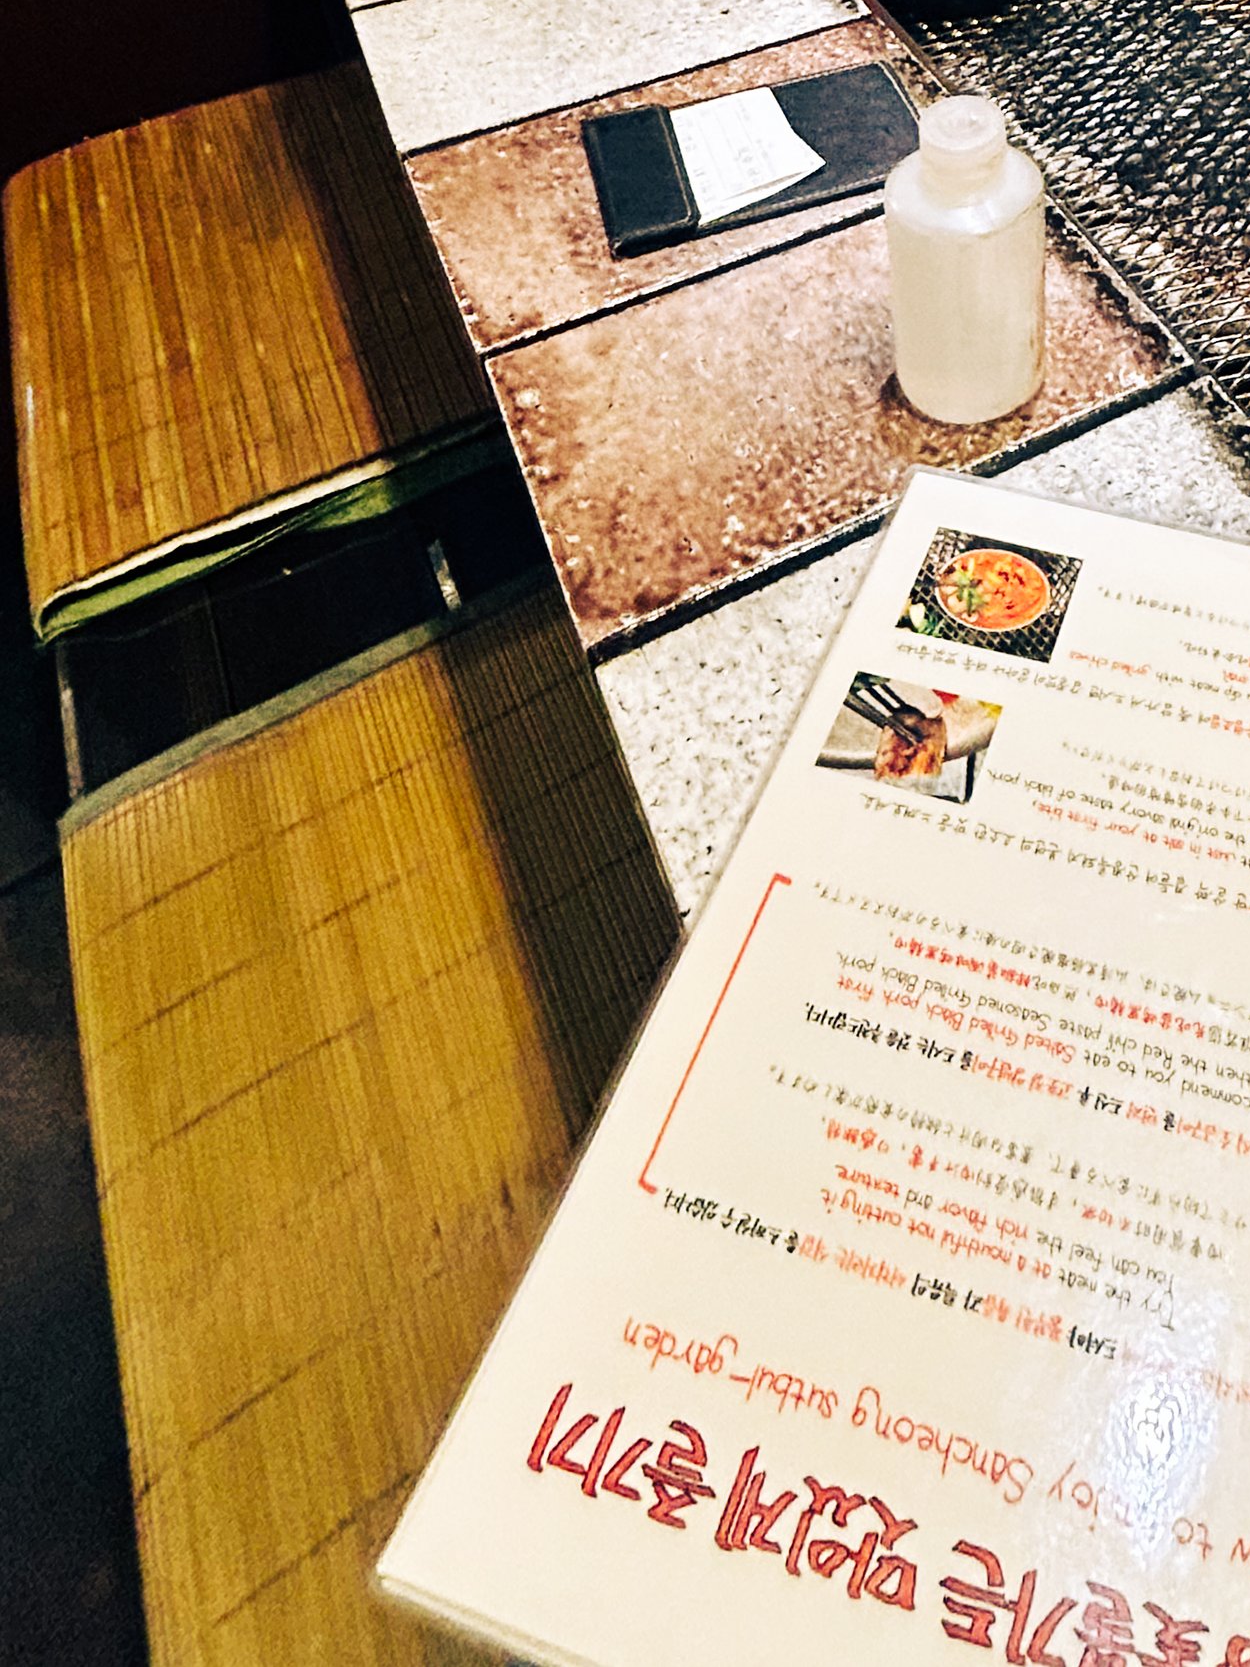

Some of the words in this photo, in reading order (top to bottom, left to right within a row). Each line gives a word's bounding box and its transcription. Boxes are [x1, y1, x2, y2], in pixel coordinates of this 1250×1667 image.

[1154, 671, 1184, 687] with
[1188, 678, 1220, 694] meat
[1055, 788, 1076, 802] of
[1080, 792, 1114, 810] taste
[1118, 800, 1165, 824] savory
[1103, 821, 1140, 836] your
[1142, 830, 1158, 844] at
[1223, 830, 1246, 847] the
[1188, 842, 1202, 860] in
[836, 951, 877, 973] pork
[836, 974, 874, 1002] first
[880, 966, 919, 998] Black
[882, 977, 926, 1010] pork
[917, 978, 972, 1009] Grilled
[972, 994, 1051, 1032] Seasoned
[1058, 1017, 1102, 1040] paste
[916, 1036, 955, 1063] 드시는
[1023, 1032, 1076, 1064] Salted
[1083, 1048, 1111, 1068] eat
[1141, 1042, 1173, 1071] Red
[1115, 1059, 1137, 1077] to
[1144, 1062, 1176, 1085] you
[1180, 1053, 1207, 1075] the
[835, 1163, 899, 1198] texture
[819, 1186, 838, 1215] it
[839, 1187, 907, 1227] cutting
[902, 1188, 933, 1211] and
[906, 1217, 936, 1240] not
[937, 1202, 987, 1233] flavor
[994, 1218, 1028, 1246] rich
[1035, 1229, 1063, 1256] the
[939, 1229, 1012, 1265] mouthful
[1067, 1242, 1103, 1273] feel
[1015, 1253, 1027, 1272] a
[1031, 1258, 1052, 1280] at
[1110, 1255, 1141, 1276] can
[1057, 1267, 1097, 1292] meat
[1104, 1282, 1132, 1309] the
[1139, 1288, 1175, 1333] Try
[623, 1319, 838, 1418] sutbul-garden
[528, 1385, 712, 1527] 즐기기
[850, 1385, 1033, 1504] Sancheong
[716, 1449, 916, 1608] 맛있게
[1171, 1516, 1213, 1562] to
